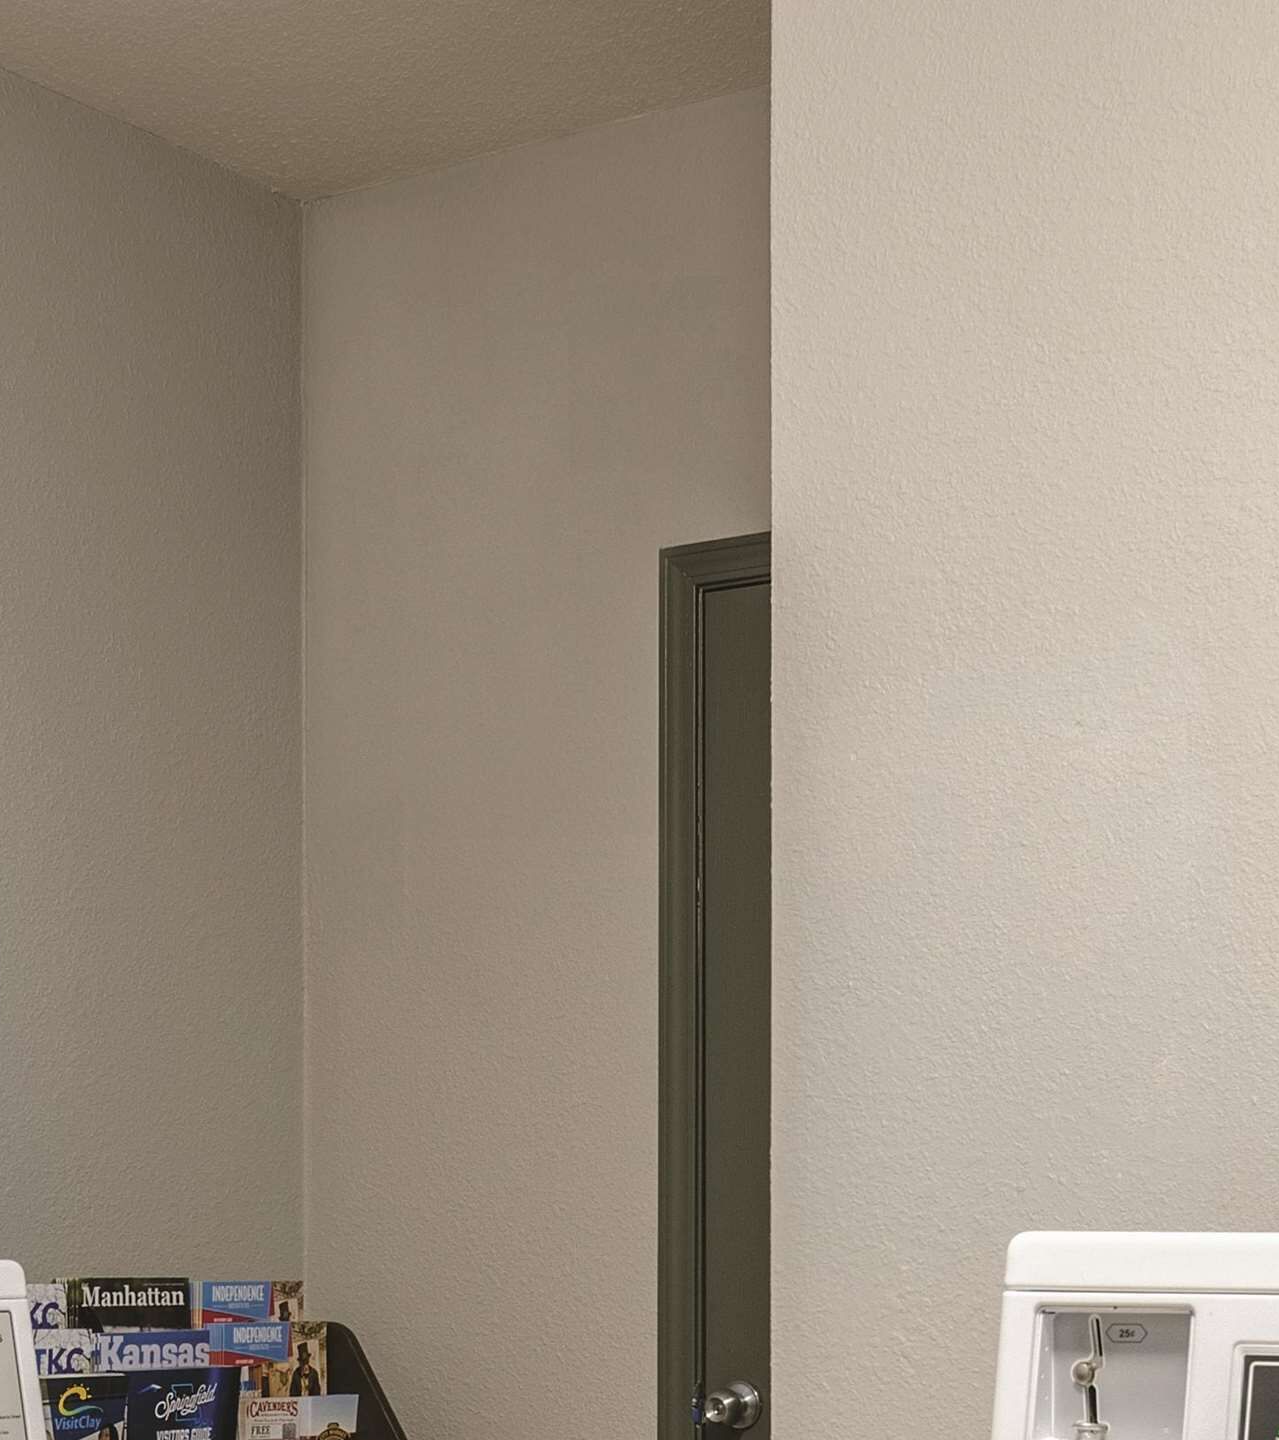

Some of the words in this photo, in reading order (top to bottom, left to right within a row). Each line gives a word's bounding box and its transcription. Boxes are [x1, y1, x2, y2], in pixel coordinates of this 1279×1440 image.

[81, 1282, 184, 1308] Manhattan
[212, 1284, 264, 1302] INDEPENDENCE
[233, 1326, 282, 1344] INDEPENDENCE
[100, 1335, 210, 1371] Kansas
[155, 1382, 217, 1421] Springfield
[249, 1400, 298, 1418] CAVENDER'S
[55, 1417, 102, 1431] VisitClay
[251, 1426, 271, 1435] FREE
